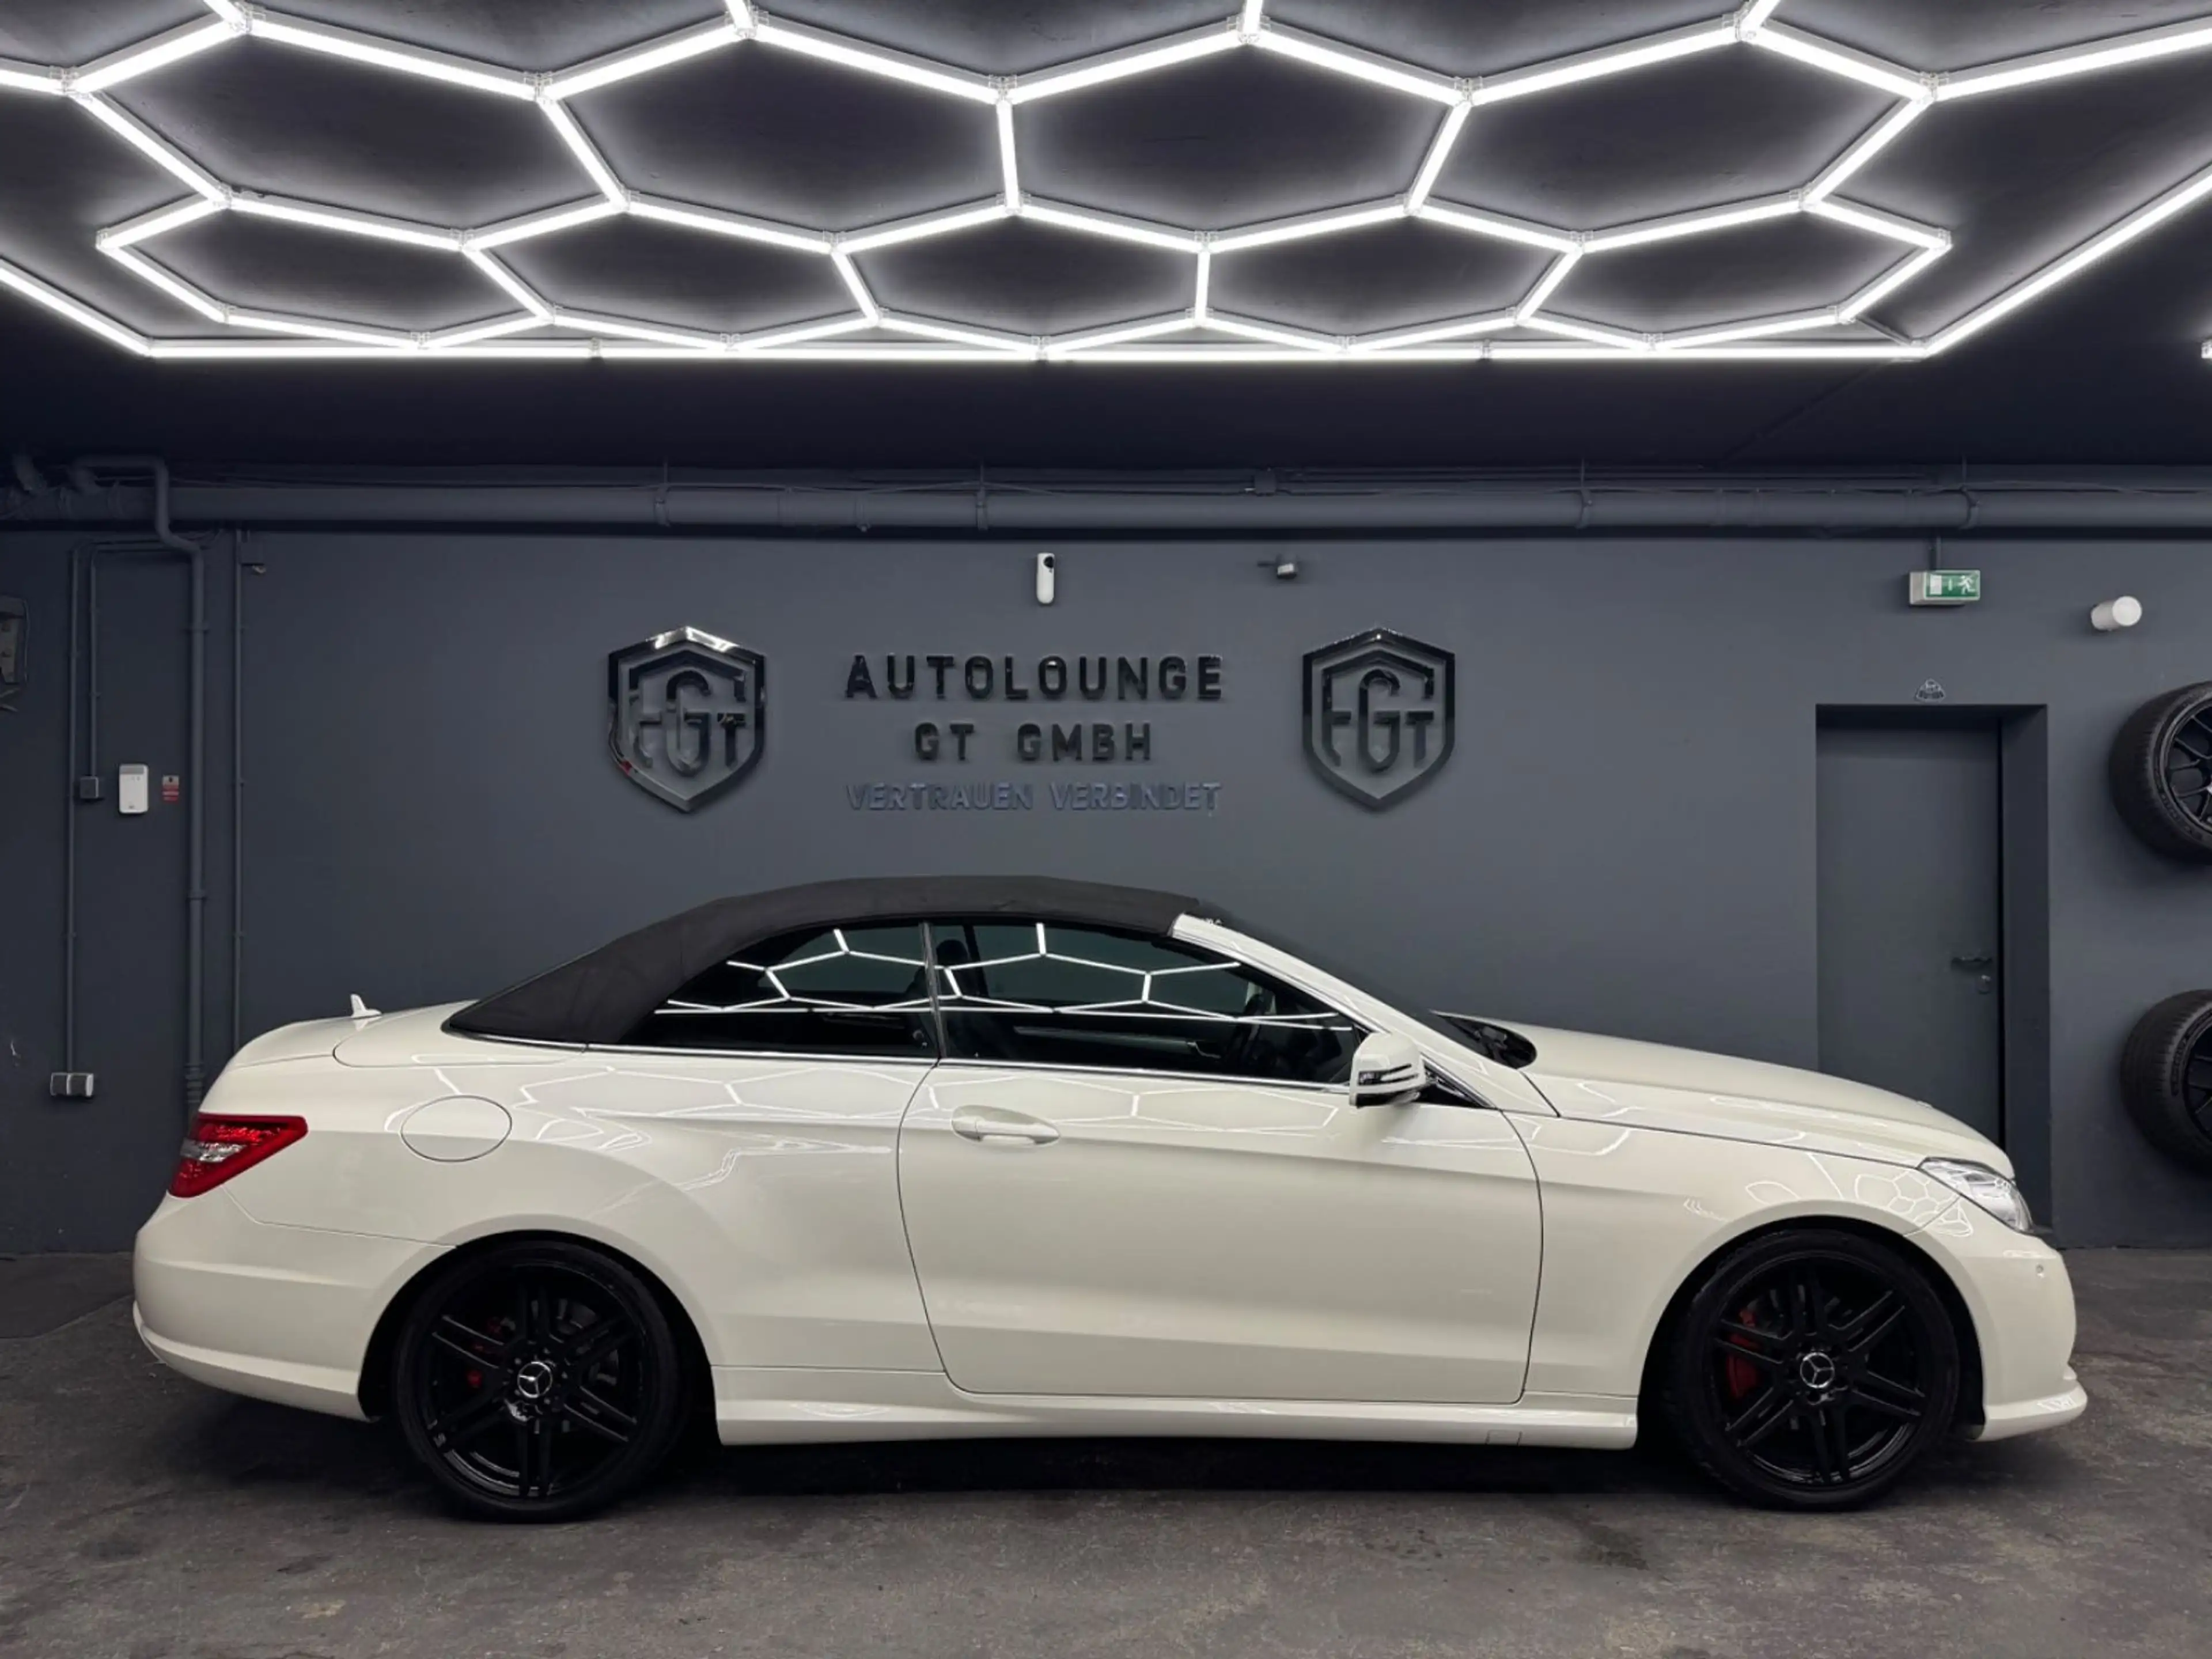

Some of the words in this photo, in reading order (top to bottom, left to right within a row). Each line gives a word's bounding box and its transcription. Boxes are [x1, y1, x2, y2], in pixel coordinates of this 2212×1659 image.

[844, 654, 1222, 700] AUTOLOUNGE
[914, 722, 975, 762] GT
[1016, 722, 1151, 762] GMBH
[846, 782, 1033, 811] VERTRAUEN
[1048, 782, 1221, 811] VERBINDET
